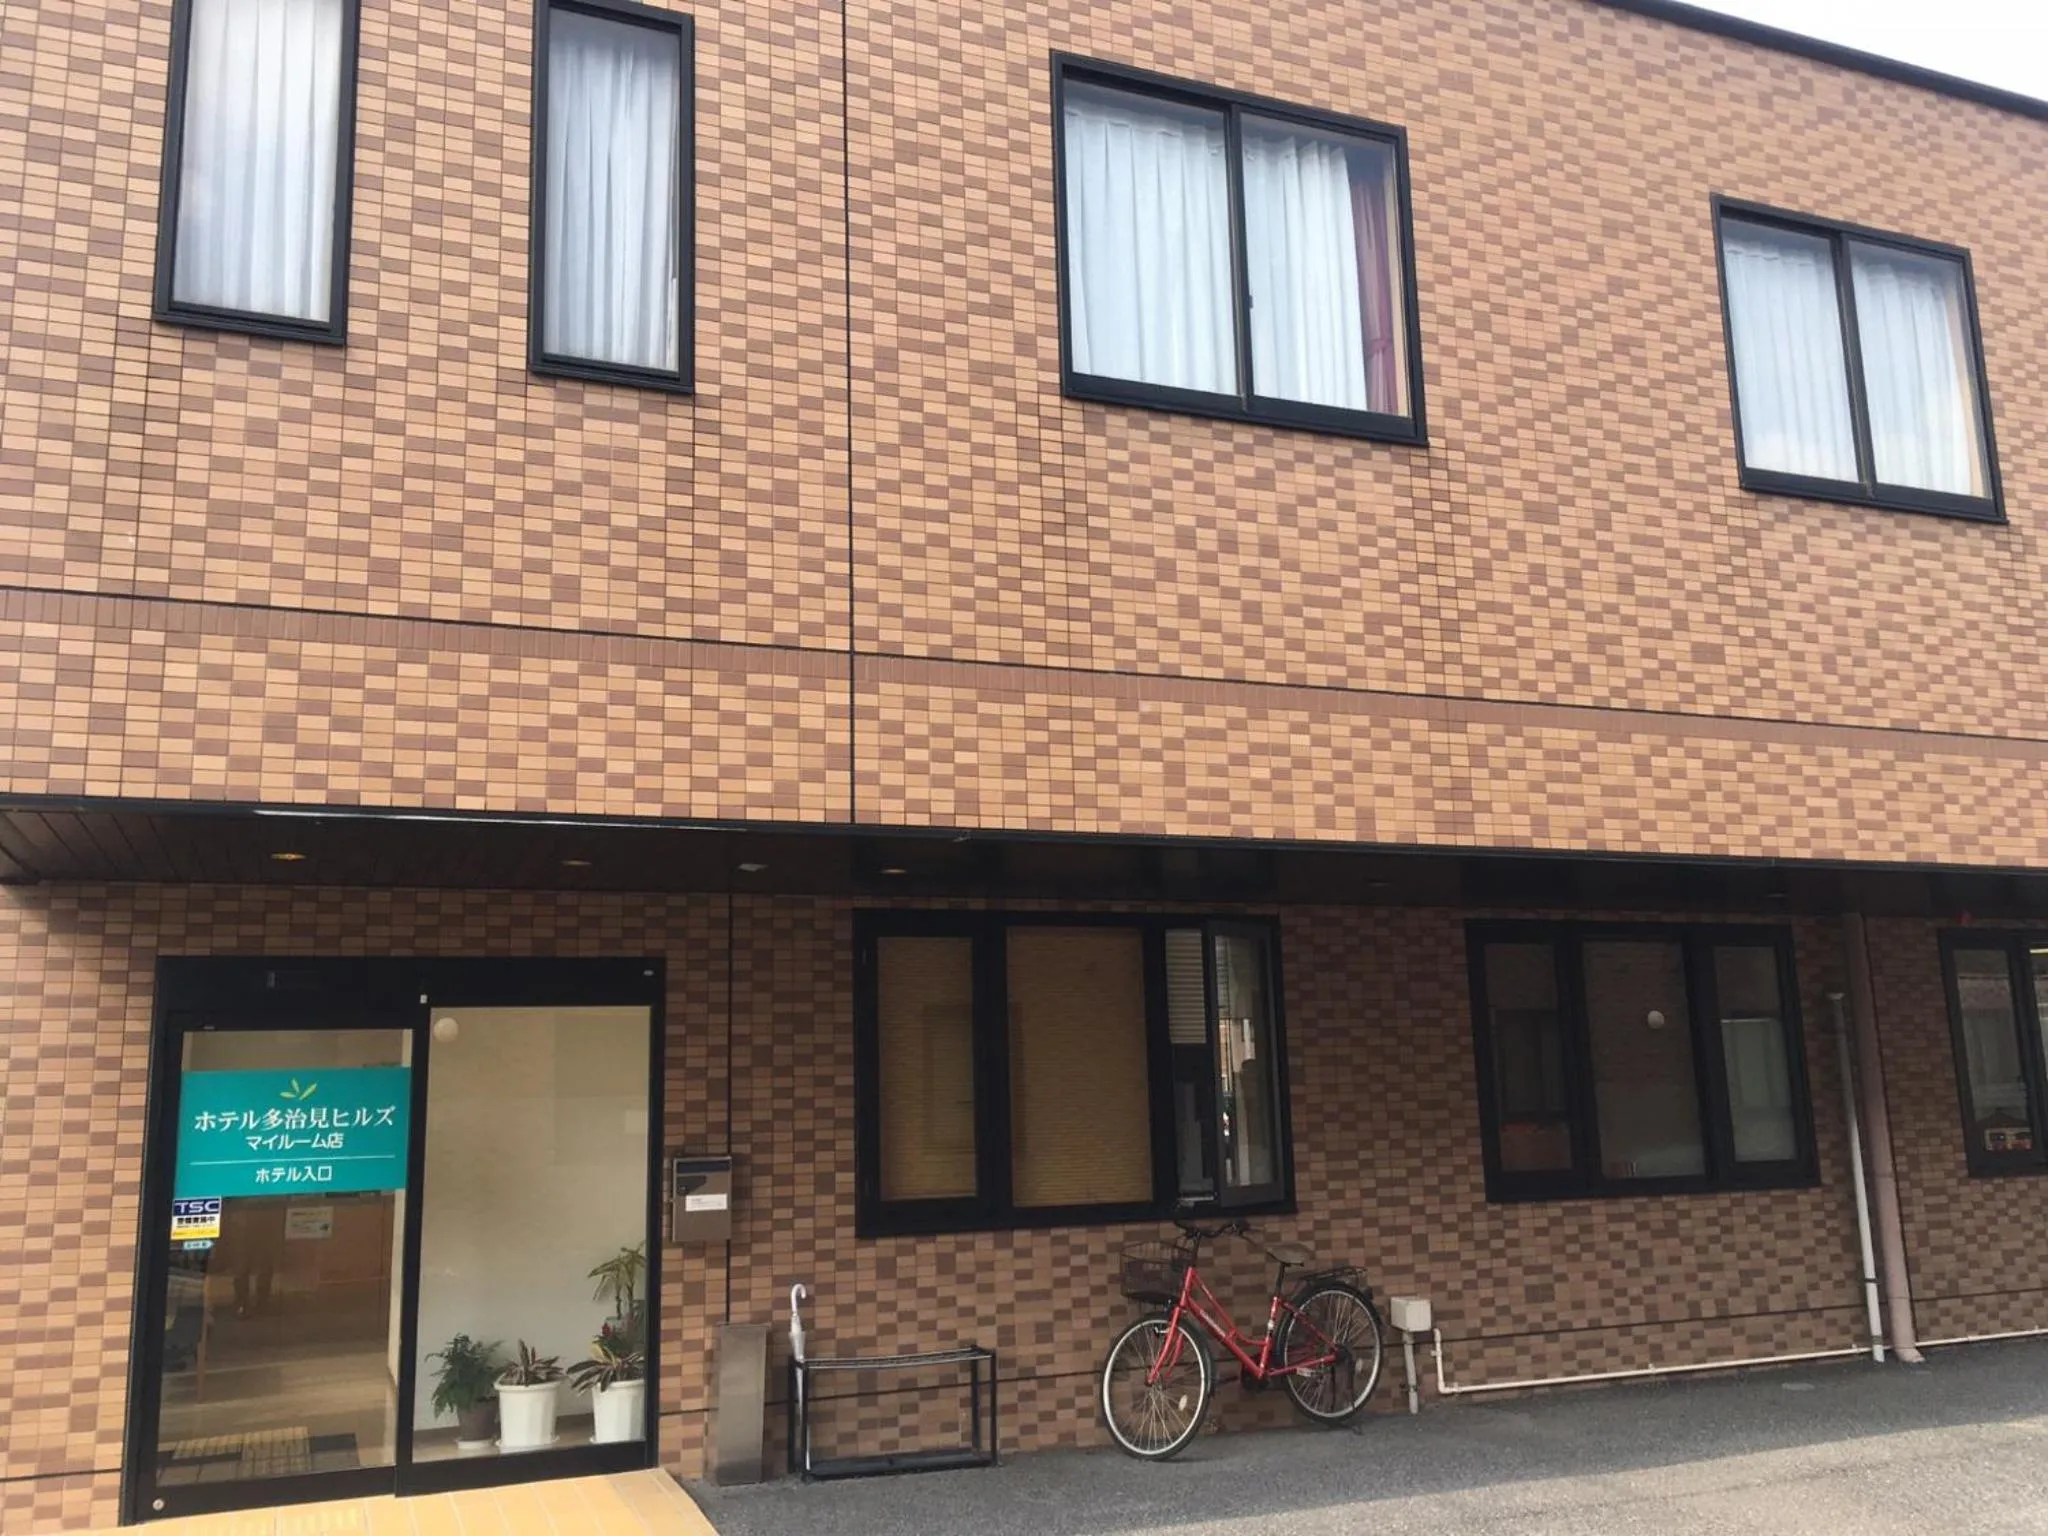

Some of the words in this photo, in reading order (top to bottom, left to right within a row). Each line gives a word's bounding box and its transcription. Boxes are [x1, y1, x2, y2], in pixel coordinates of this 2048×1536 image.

[194, 1106, 396, 1132] ホテル多治見ヒルズ
[246, 1132, 344, 1151] マイルーム店
[255, 1165, 333, 1184] ホテル入口
[174, 1200, 219, 1214] TSC
